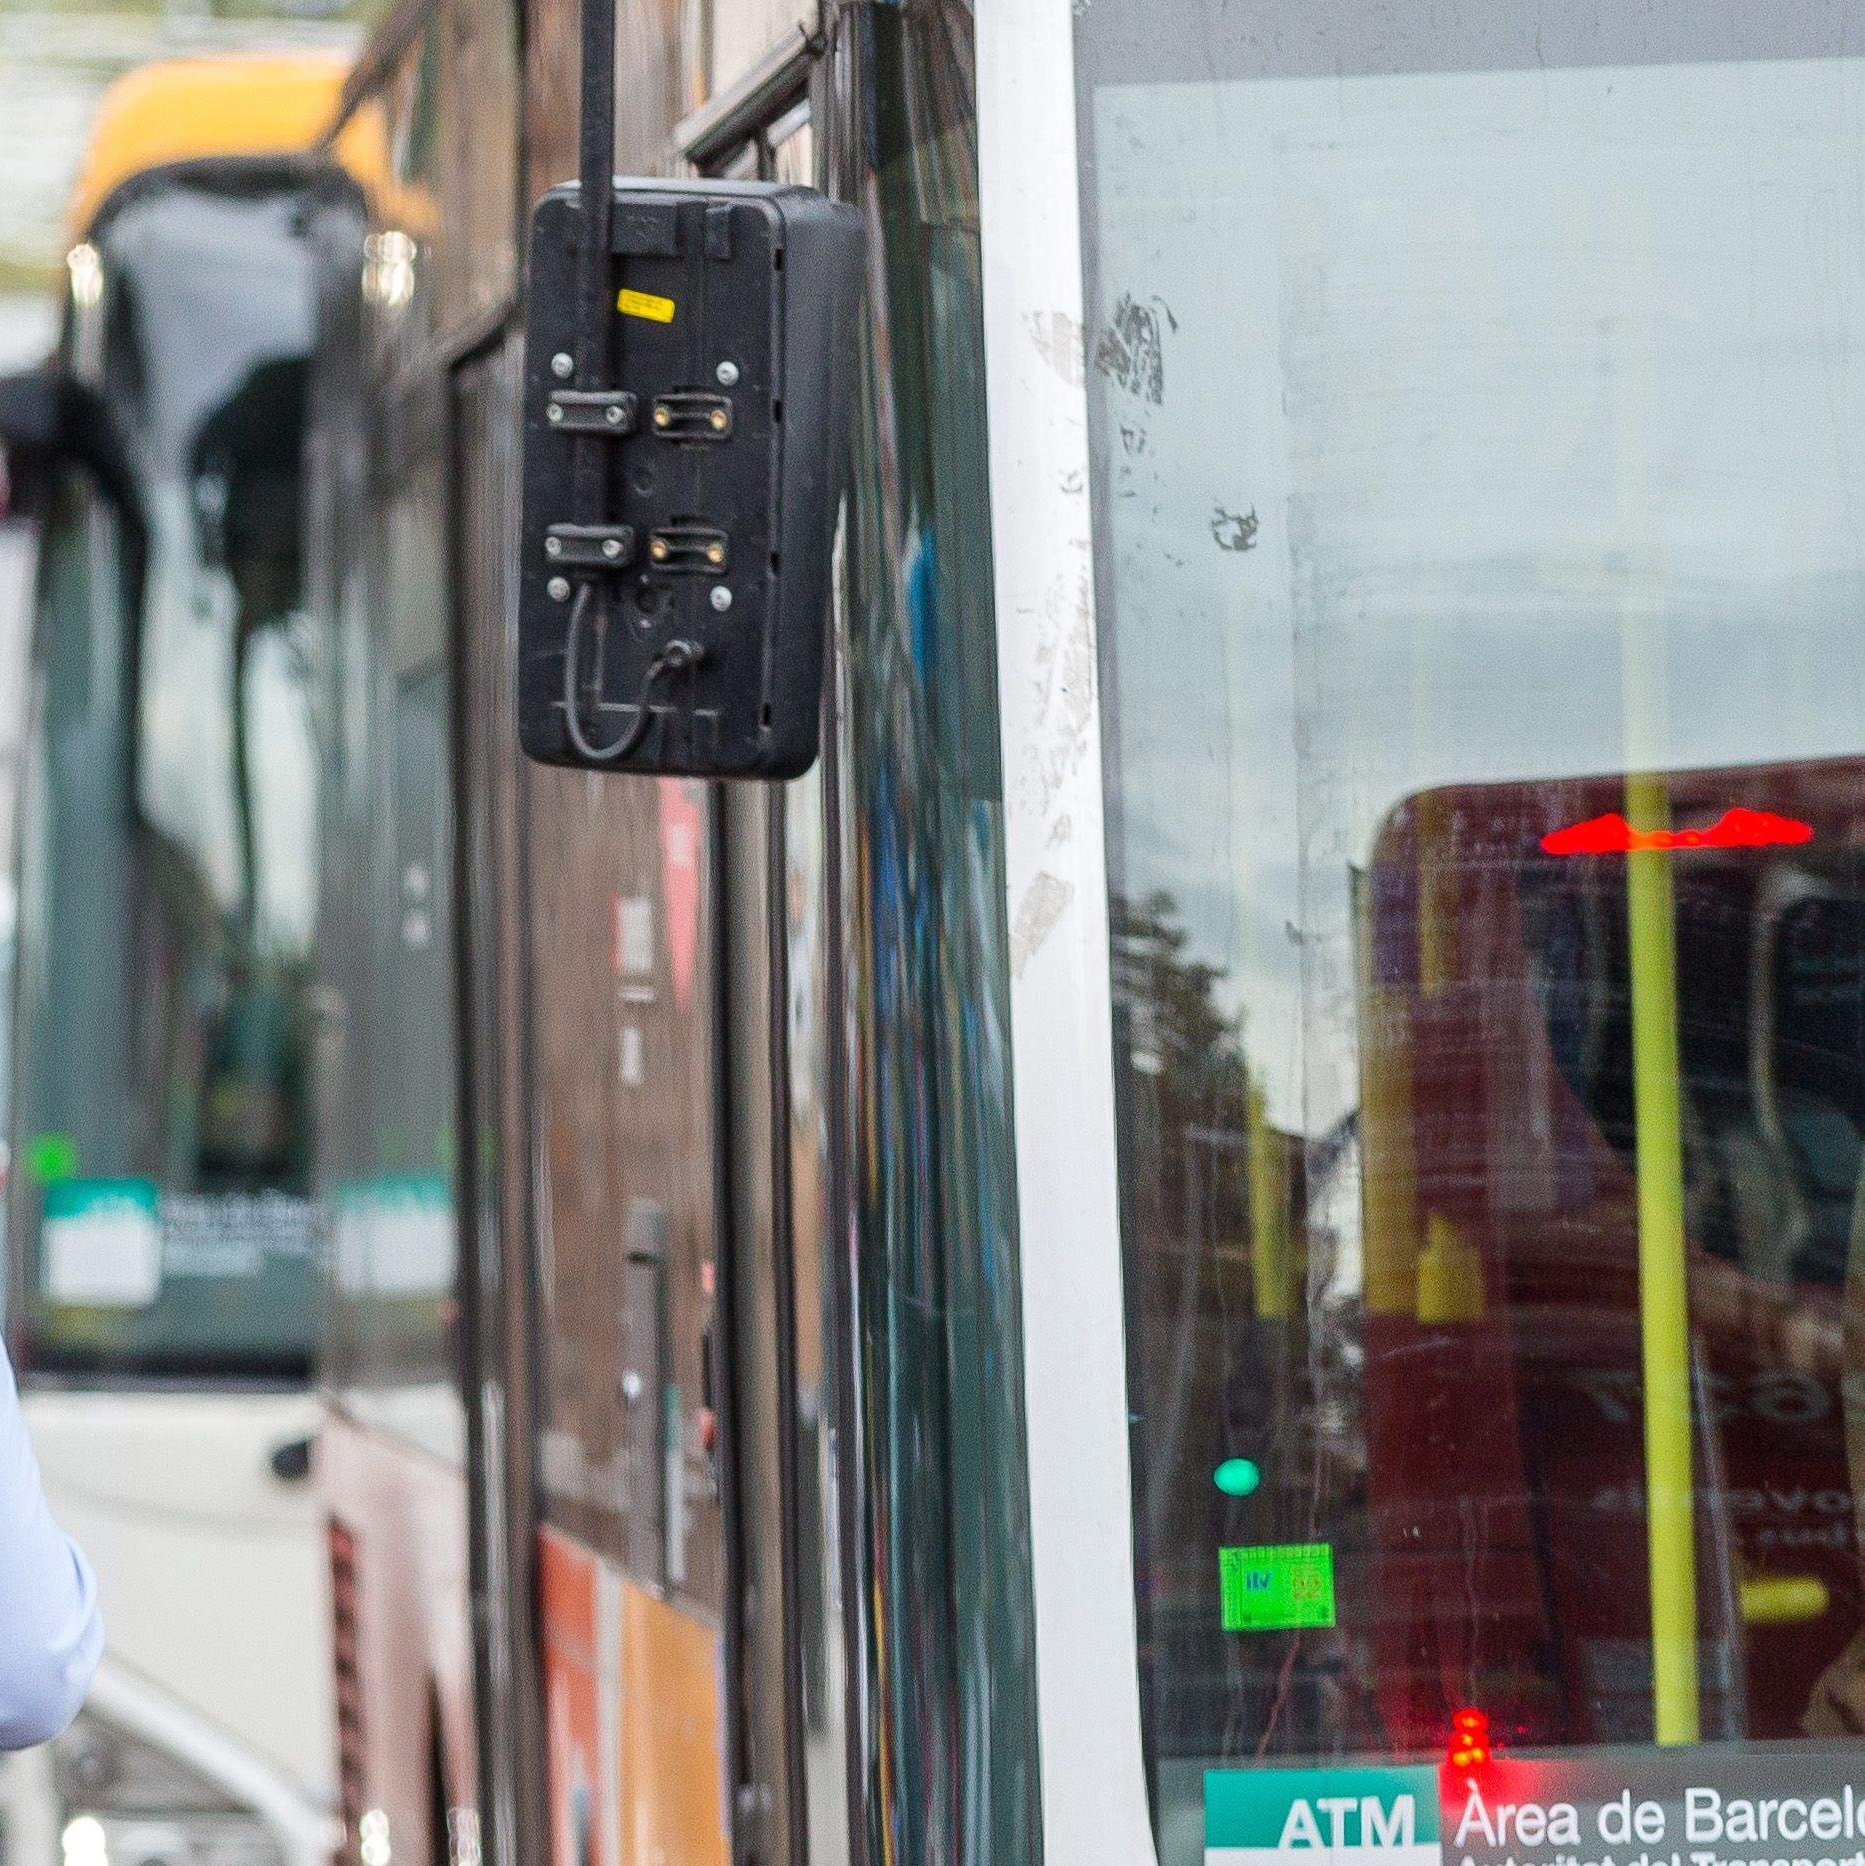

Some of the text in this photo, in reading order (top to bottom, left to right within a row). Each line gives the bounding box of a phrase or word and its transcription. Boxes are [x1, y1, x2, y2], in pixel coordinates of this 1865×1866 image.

[1277, 1795, 1416, 1849] ATM
[1454, 1781, 1580, 1847] Àrea
[1597, 1789, 1666, 1846] de
